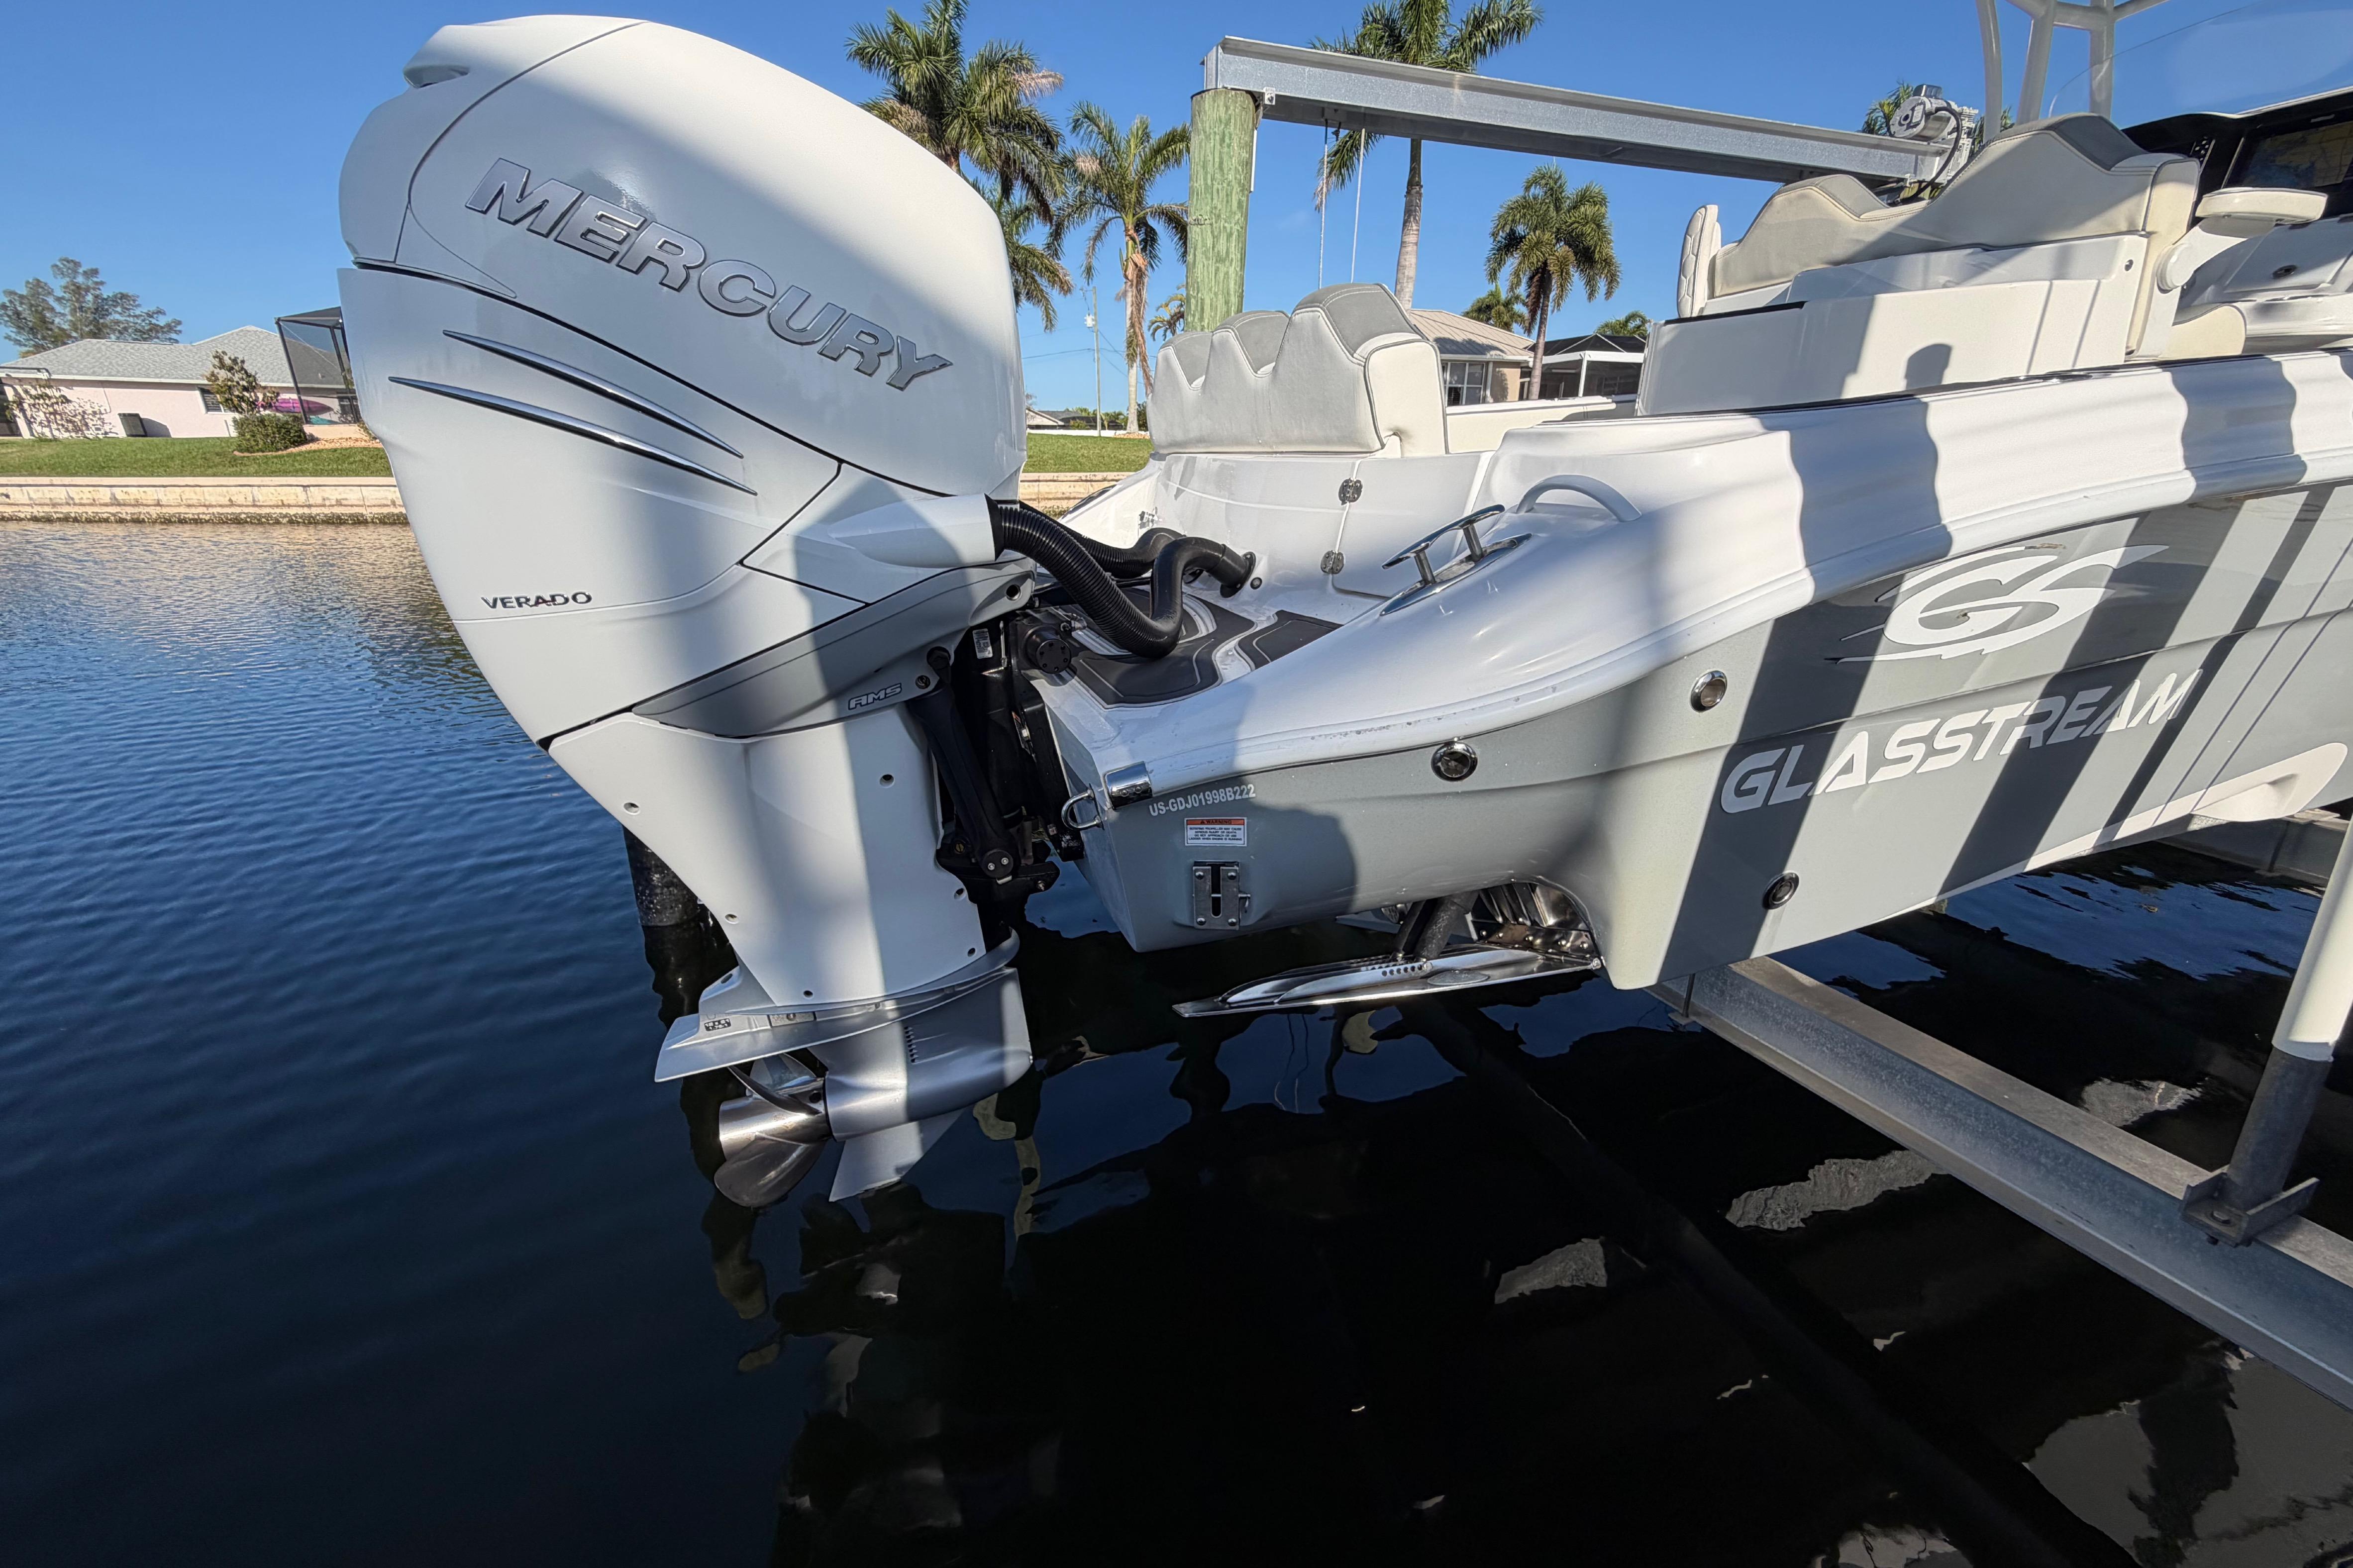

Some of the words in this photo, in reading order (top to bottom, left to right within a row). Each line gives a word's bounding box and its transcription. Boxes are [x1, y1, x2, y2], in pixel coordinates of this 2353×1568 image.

[465, 157, 953, 391] MERCURY
[481, 591, 593, 609] VERADO
[848, 682, 903, 710] AMS
[1720, 669, 2204, 814] GLASSTREAM
[1148, 784, 1256, 817] US-GDJ01998B222
